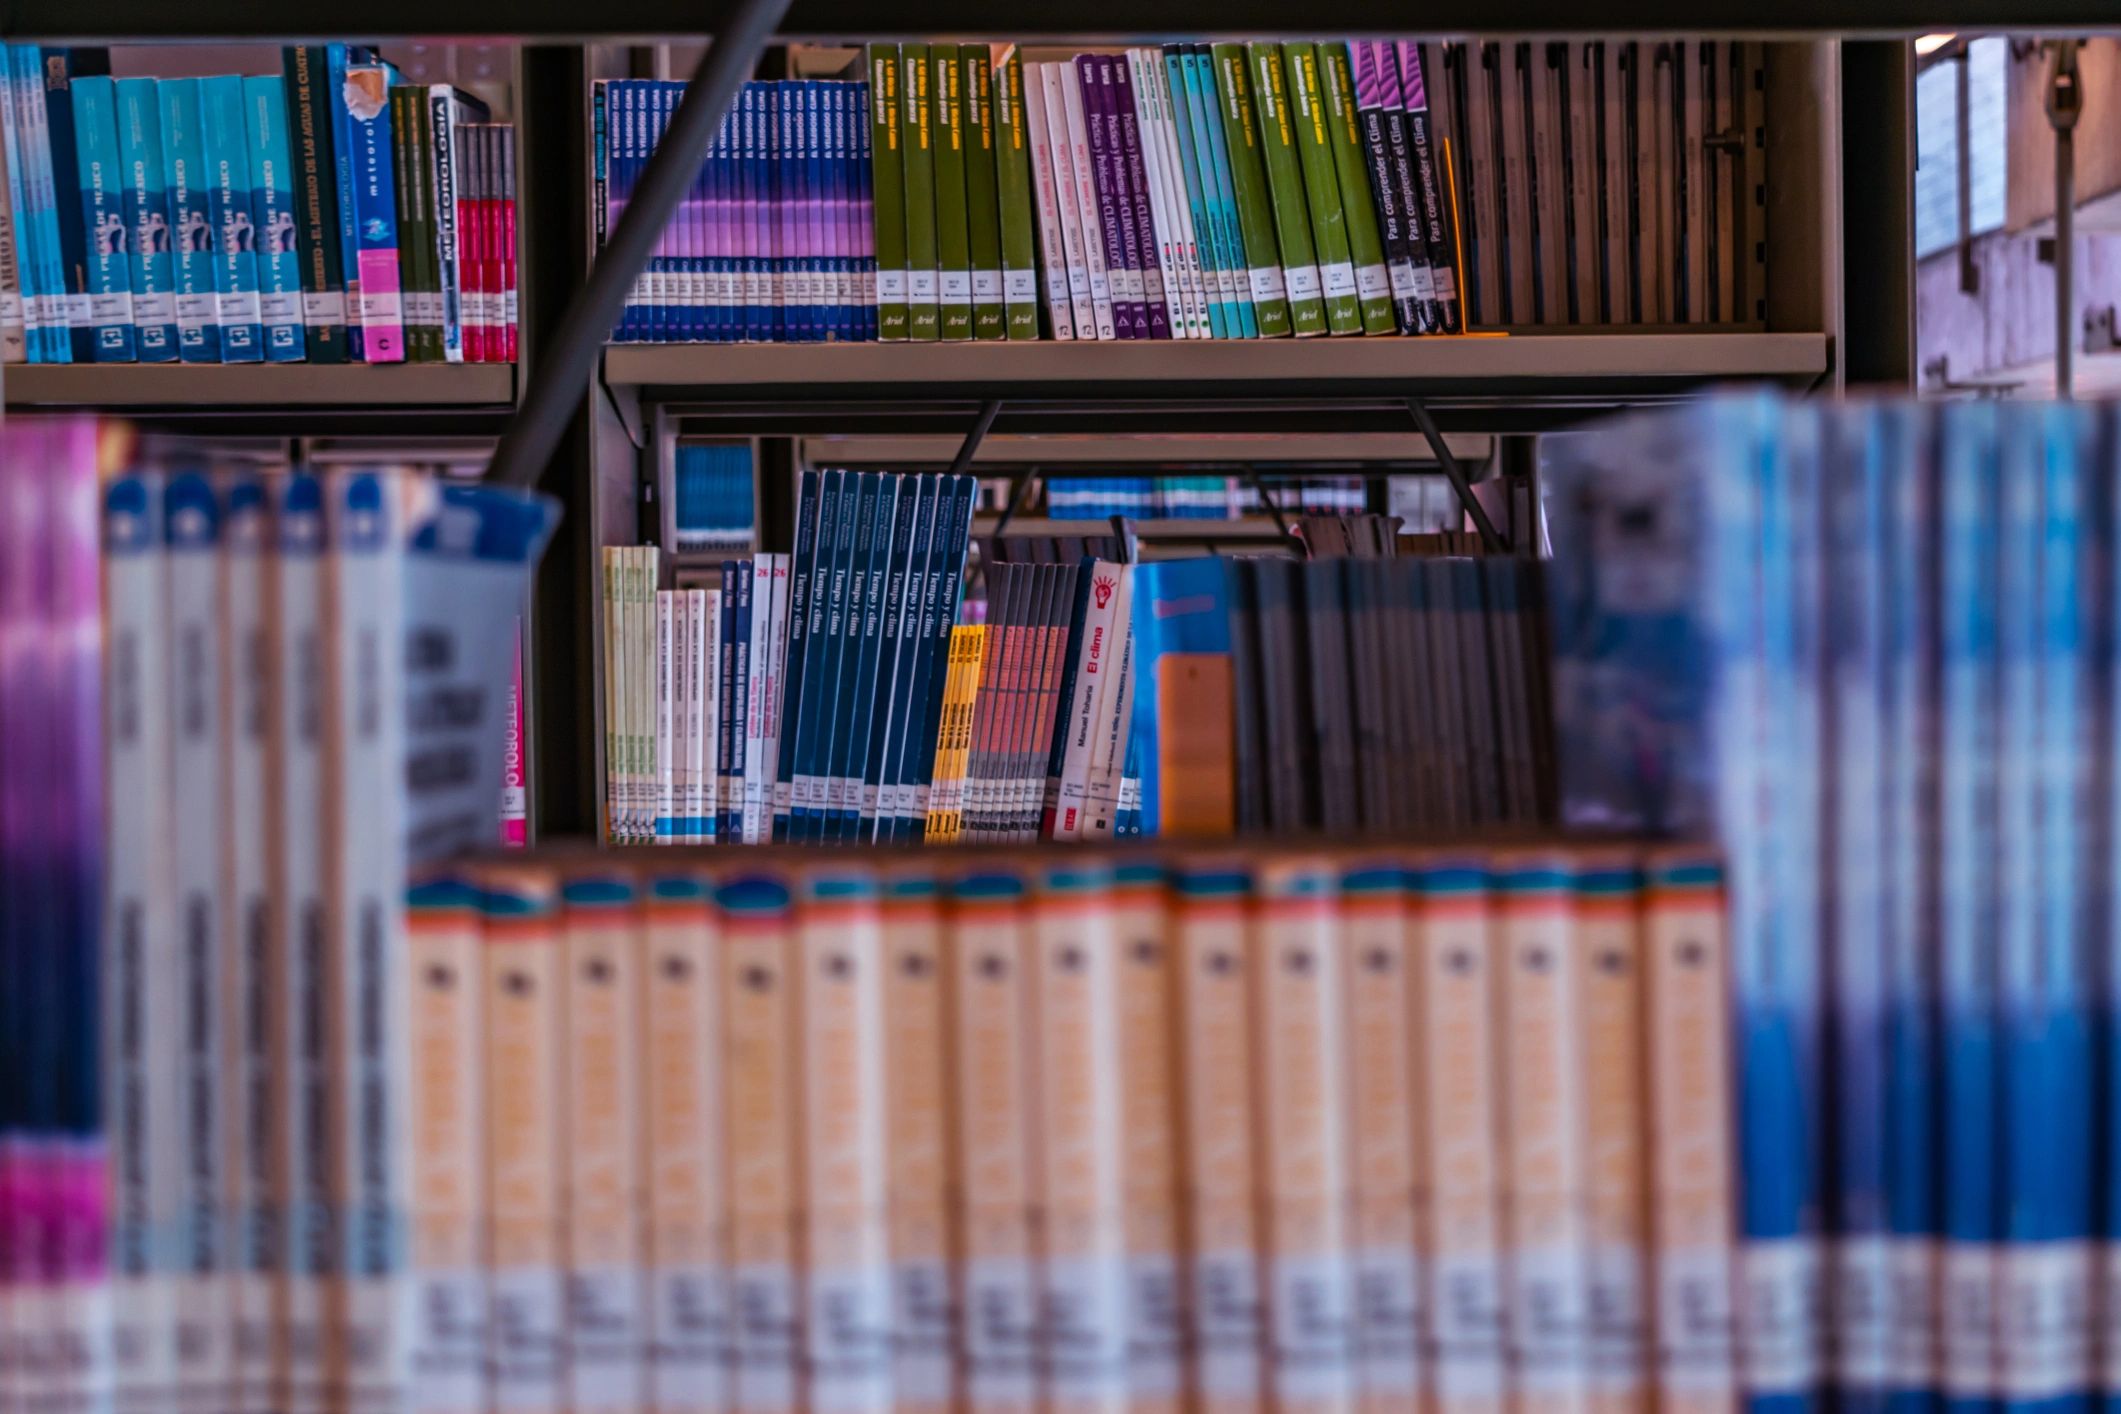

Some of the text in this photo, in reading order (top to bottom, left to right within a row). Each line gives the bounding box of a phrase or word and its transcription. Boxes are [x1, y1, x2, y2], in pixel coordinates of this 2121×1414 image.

[298, 86, 310, 101] DE
[300, 103, 313, 136] AGUAS
[1090, 113, 1102, 148] Prácticas
[1108, 115, 1118, 149] Prácticas
[1123, 113, 1134, 148] Prácticas
[302, 139, 315, 157] LAS
[364, 121, 379, 197] meteorol
[304, 159, 316, 174] DE
[436, 103, 456, 261] METEOROLOGÍA
[1096, 154, 1108, 194] Problemas
[1114, 156, 1126, 195] Problemas
[1129, 154, 1142, 194] Problemas
[1369, 114, 1398, 240] Para comprender el Clima
[1390, 115, 1419, 240] Para comprender el Clima
[1414, 116, 1440, 242] Para comprender el Clima
[180, 207, 188, 224] DE
[306, 175, 321, 226] MISTERIO
[1102, 195, 1110, 204] de
[1119, 196, 1128, 206] de
[1136, 194, 1145, 204] de
[139, 208, 148, 224] DE
[1104, 206, 1121, 270] CLIMATOLOGÍ
[1121, 207, 1138, 270] CLIMATOLOGÍ
[1137, 205, 1156, 269] CLIMATOLOGÍ
[883, 315, 904, 326] Ariel
[915, 314, 935, 326] Ariel
[947, 316, 968, 326] Ariel
[979, 314, 999, 326] Ariel
[1264, 309, 1283, 322] Ariel
[1299, 308, 1318, 322] Ariel
[1334, 308, 1353, 321] Ariel
[757, 567, 768, 578] 26
[774, 568, 786, 578] 26
[795, 572, 808, 606] Tiempo
[815, 566, 828, 600] Tiempo
[832, 568, 846, 602] Tiempo
[852, 570, 865, 603] Tiempo
[870, 569, 882, 603] Tiempo
[909, 571, 922, 604] Tiempo
[927, 571, 940, 604] Tiempo
[944, 571, 957, 604] Tiempo
[792, 614, 803, 640] clima
[812, 608, 823, 634] clima
[830, 610, 840, 636] clima
[848, 612, 860, 637] clima
[866, 612, 878, 637] clima
[906, 612, 917, 638] clima
[923, 612, 934, 638] clima
[940, 612, 950, 638] clima
[1086, 626, 1104, 674] El clima
[737, 676, 745, 684] DE
[1078, 685, 1093, 748] Manuel Toharia
[503, 684, 519, 789] METEOROLO
